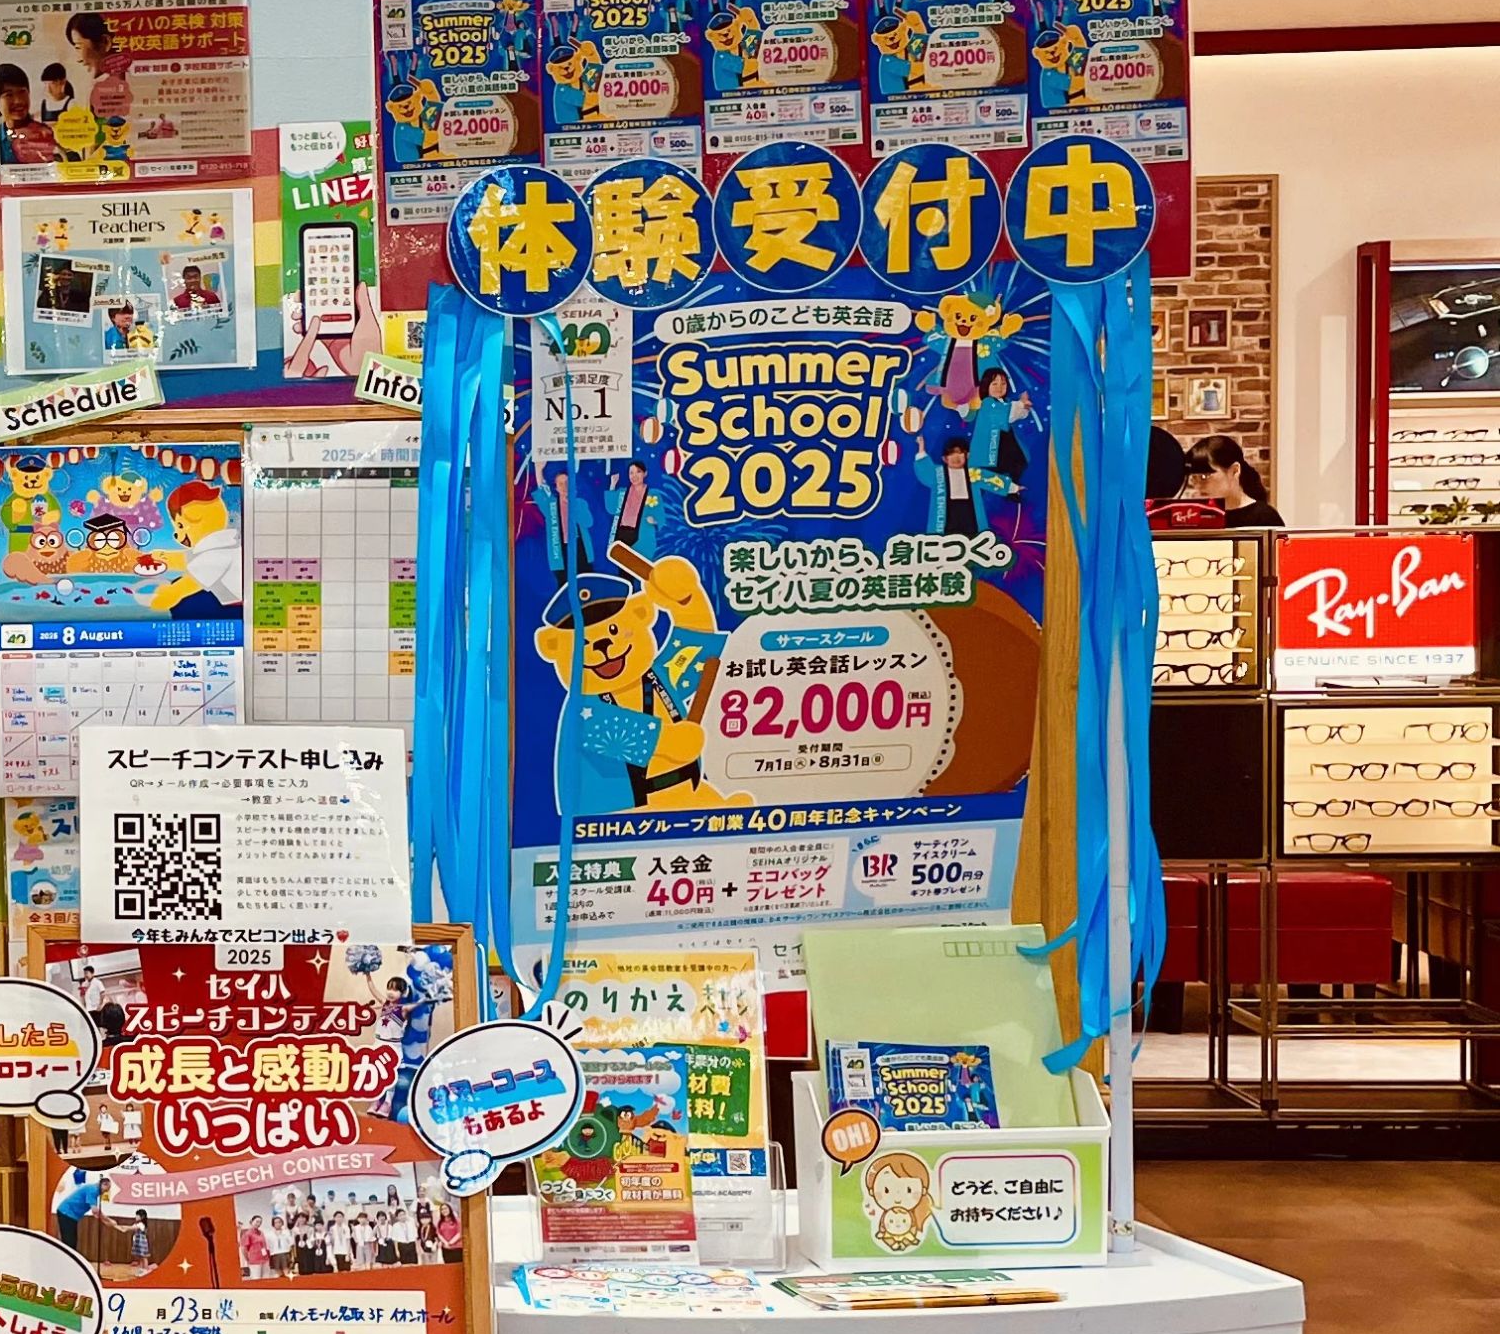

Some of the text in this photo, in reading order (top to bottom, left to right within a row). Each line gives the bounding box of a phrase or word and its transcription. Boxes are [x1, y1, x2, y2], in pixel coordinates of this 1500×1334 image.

[421, 15, 492, 30] Summer
[591, 8, 647, 28] 2025
[428, 29, 489, 45] School
[431, 47, 486, 67] 2025
[101, 201, 151, 217] SEIHA
[88, 218, 165, 235] Teachers
[467, 162, 1141, 295] 体験受付中
[672, 306, 894, 335] 0歳からのこども英会話
[667, 351, 901, 396] Summer
[6, 380, 138, 432] Schedule
[685, 395, 883, 446] School
[689, 449, 873, 517] 2025
[730, 538, 1006, 573] 楽しいから、身につく。
[731, 572, 965, 604] セイハ夏の英語体験
[62, 626, 124, 645] 8 August
[776, 632, 874, 648] サマースクール
[726, 652, 927, 679] お試し英会話レッスン
[1284, 653, 1465, 667] GENUINE SINCE 1937
[752, 680, 931, 739] 2,000円
[798, 743, 844, 753] 受付期間
[575, 804, 962, 838] SEIHAグループ創業40周年記念キャンペーン
[914, 838, 969, 849] サーティワン
[752, 854, 828, 867] SEIHAオリジナル
[912, 849, 977, 860] アイスクリーム
[648, 855, 712, 876] 入会金
[748, 865, 832, 883] エコバッグ
[911, 862, 984, 885] 500円分
[647, 878, 713, 907] 40円
[747, 882, 826, 903] プレゼント
[131, 928, 334, 944] 今年もみんなでスピコン出よう
[227, 950, 271, 965] 2025
[206, 974, 291, 1000] セイハ
[564, 983, 686, 1013] のりかえ
[126, 1003, 371, 1033] スピーチコンテスト
[117, 1041, 396, 1094] 成長と感動が
[880, 1067, 948, 1081] Summer
[887, 1081, 946, 1095] School
[891, 1097, 946, 1115] 2025
[163, 1100, 350, 1149] いっぱい
[463, 1100, 545, 1136] もあるよ
[832, 1121, 870, 1153] OH!
[130, 1152, 374, 1198] SEIHA SPEECH CONTEST
[951, 1179, 1064, 1195] どうぞ、ご自由に
[107, 1292, 127, 1323] 9
[156, 1309, 167, 1320] 月
[170, 1296, 200, 1325] 23
[202, 1308, 212, 1320] 日
